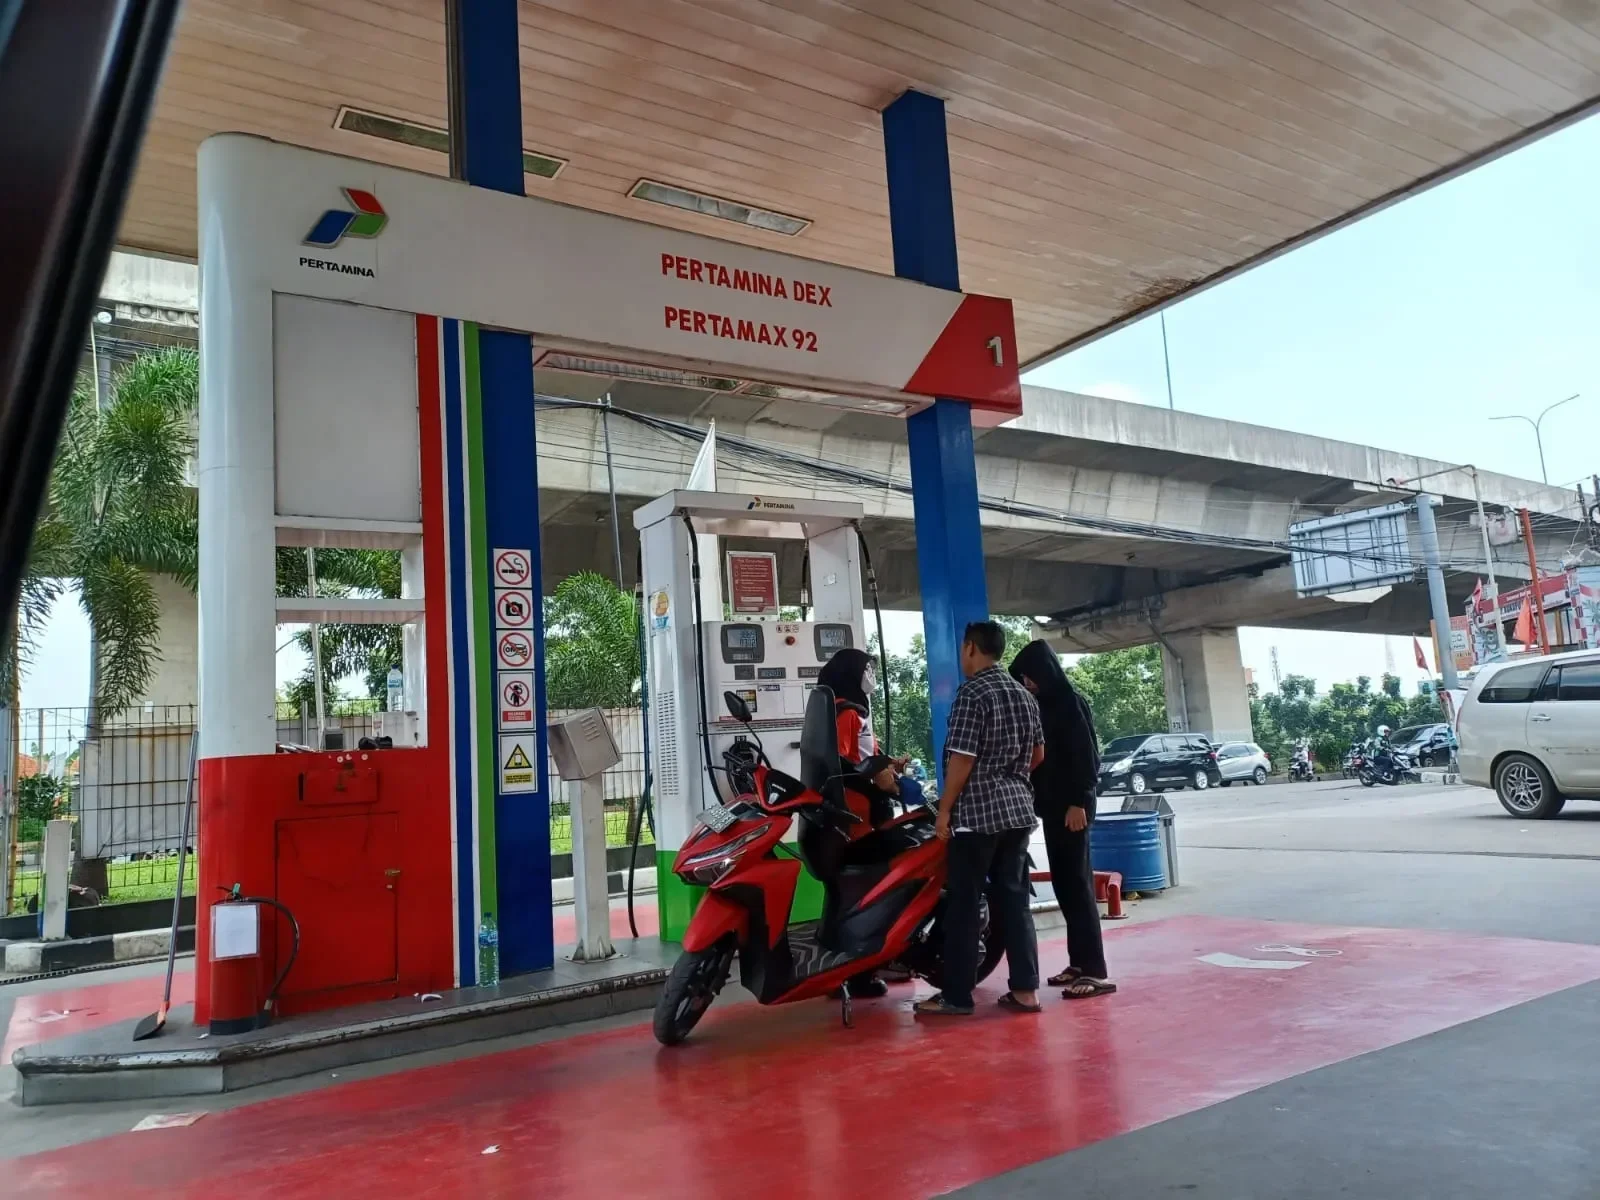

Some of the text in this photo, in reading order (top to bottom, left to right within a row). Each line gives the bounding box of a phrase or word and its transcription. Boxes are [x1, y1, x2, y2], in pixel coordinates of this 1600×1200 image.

[299, 257, 375, 278] PERTAMINA
[661, 253, 832, 307] PERTAMINA DEX
[664, 306, 818, 352] PERTAMAX 92
[987, 336, 1003, 367] 1
[763, 502, 795, 510] PERTAMINA
